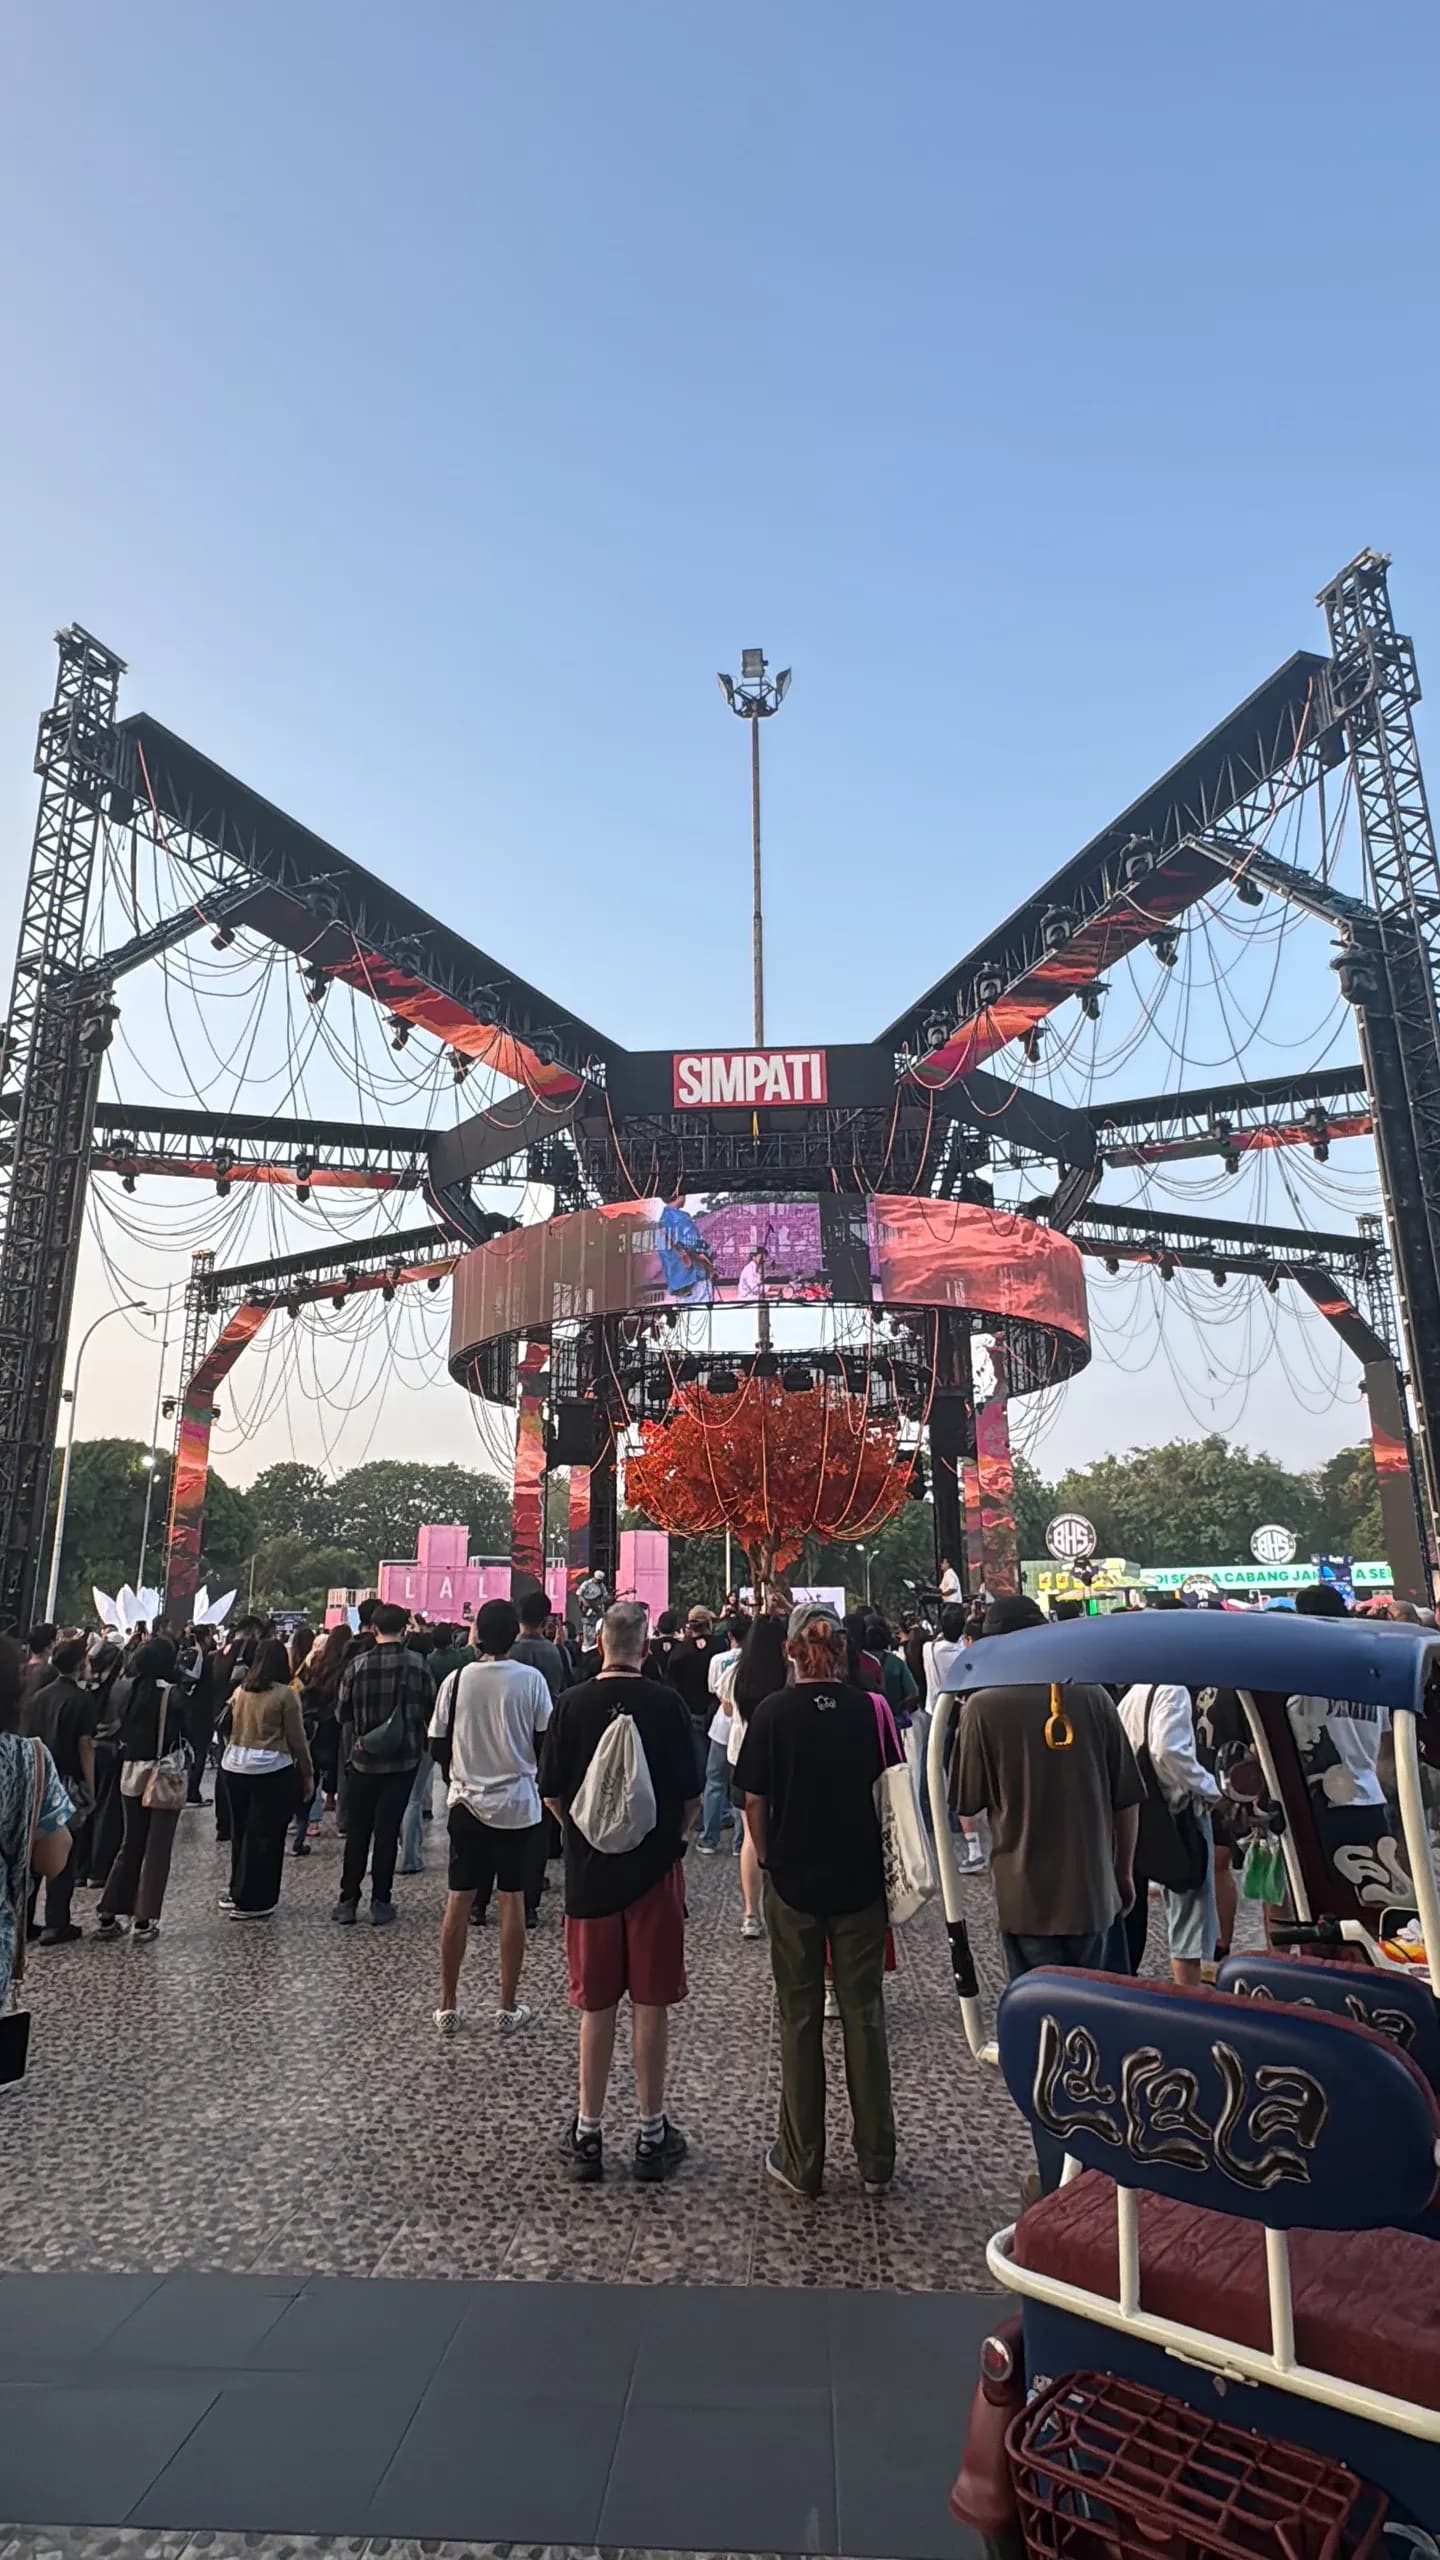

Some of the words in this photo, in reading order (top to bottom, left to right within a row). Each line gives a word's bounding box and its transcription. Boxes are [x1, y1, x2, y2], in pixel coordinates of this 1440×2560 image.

[678, 1053, 822, 1104] SIMPATI
[1053, 1520, 1089, 1556] BHS
[1257, 1529, 1290, 1561] BHS
[1224, 1570, 1289, 1583] CABANG
